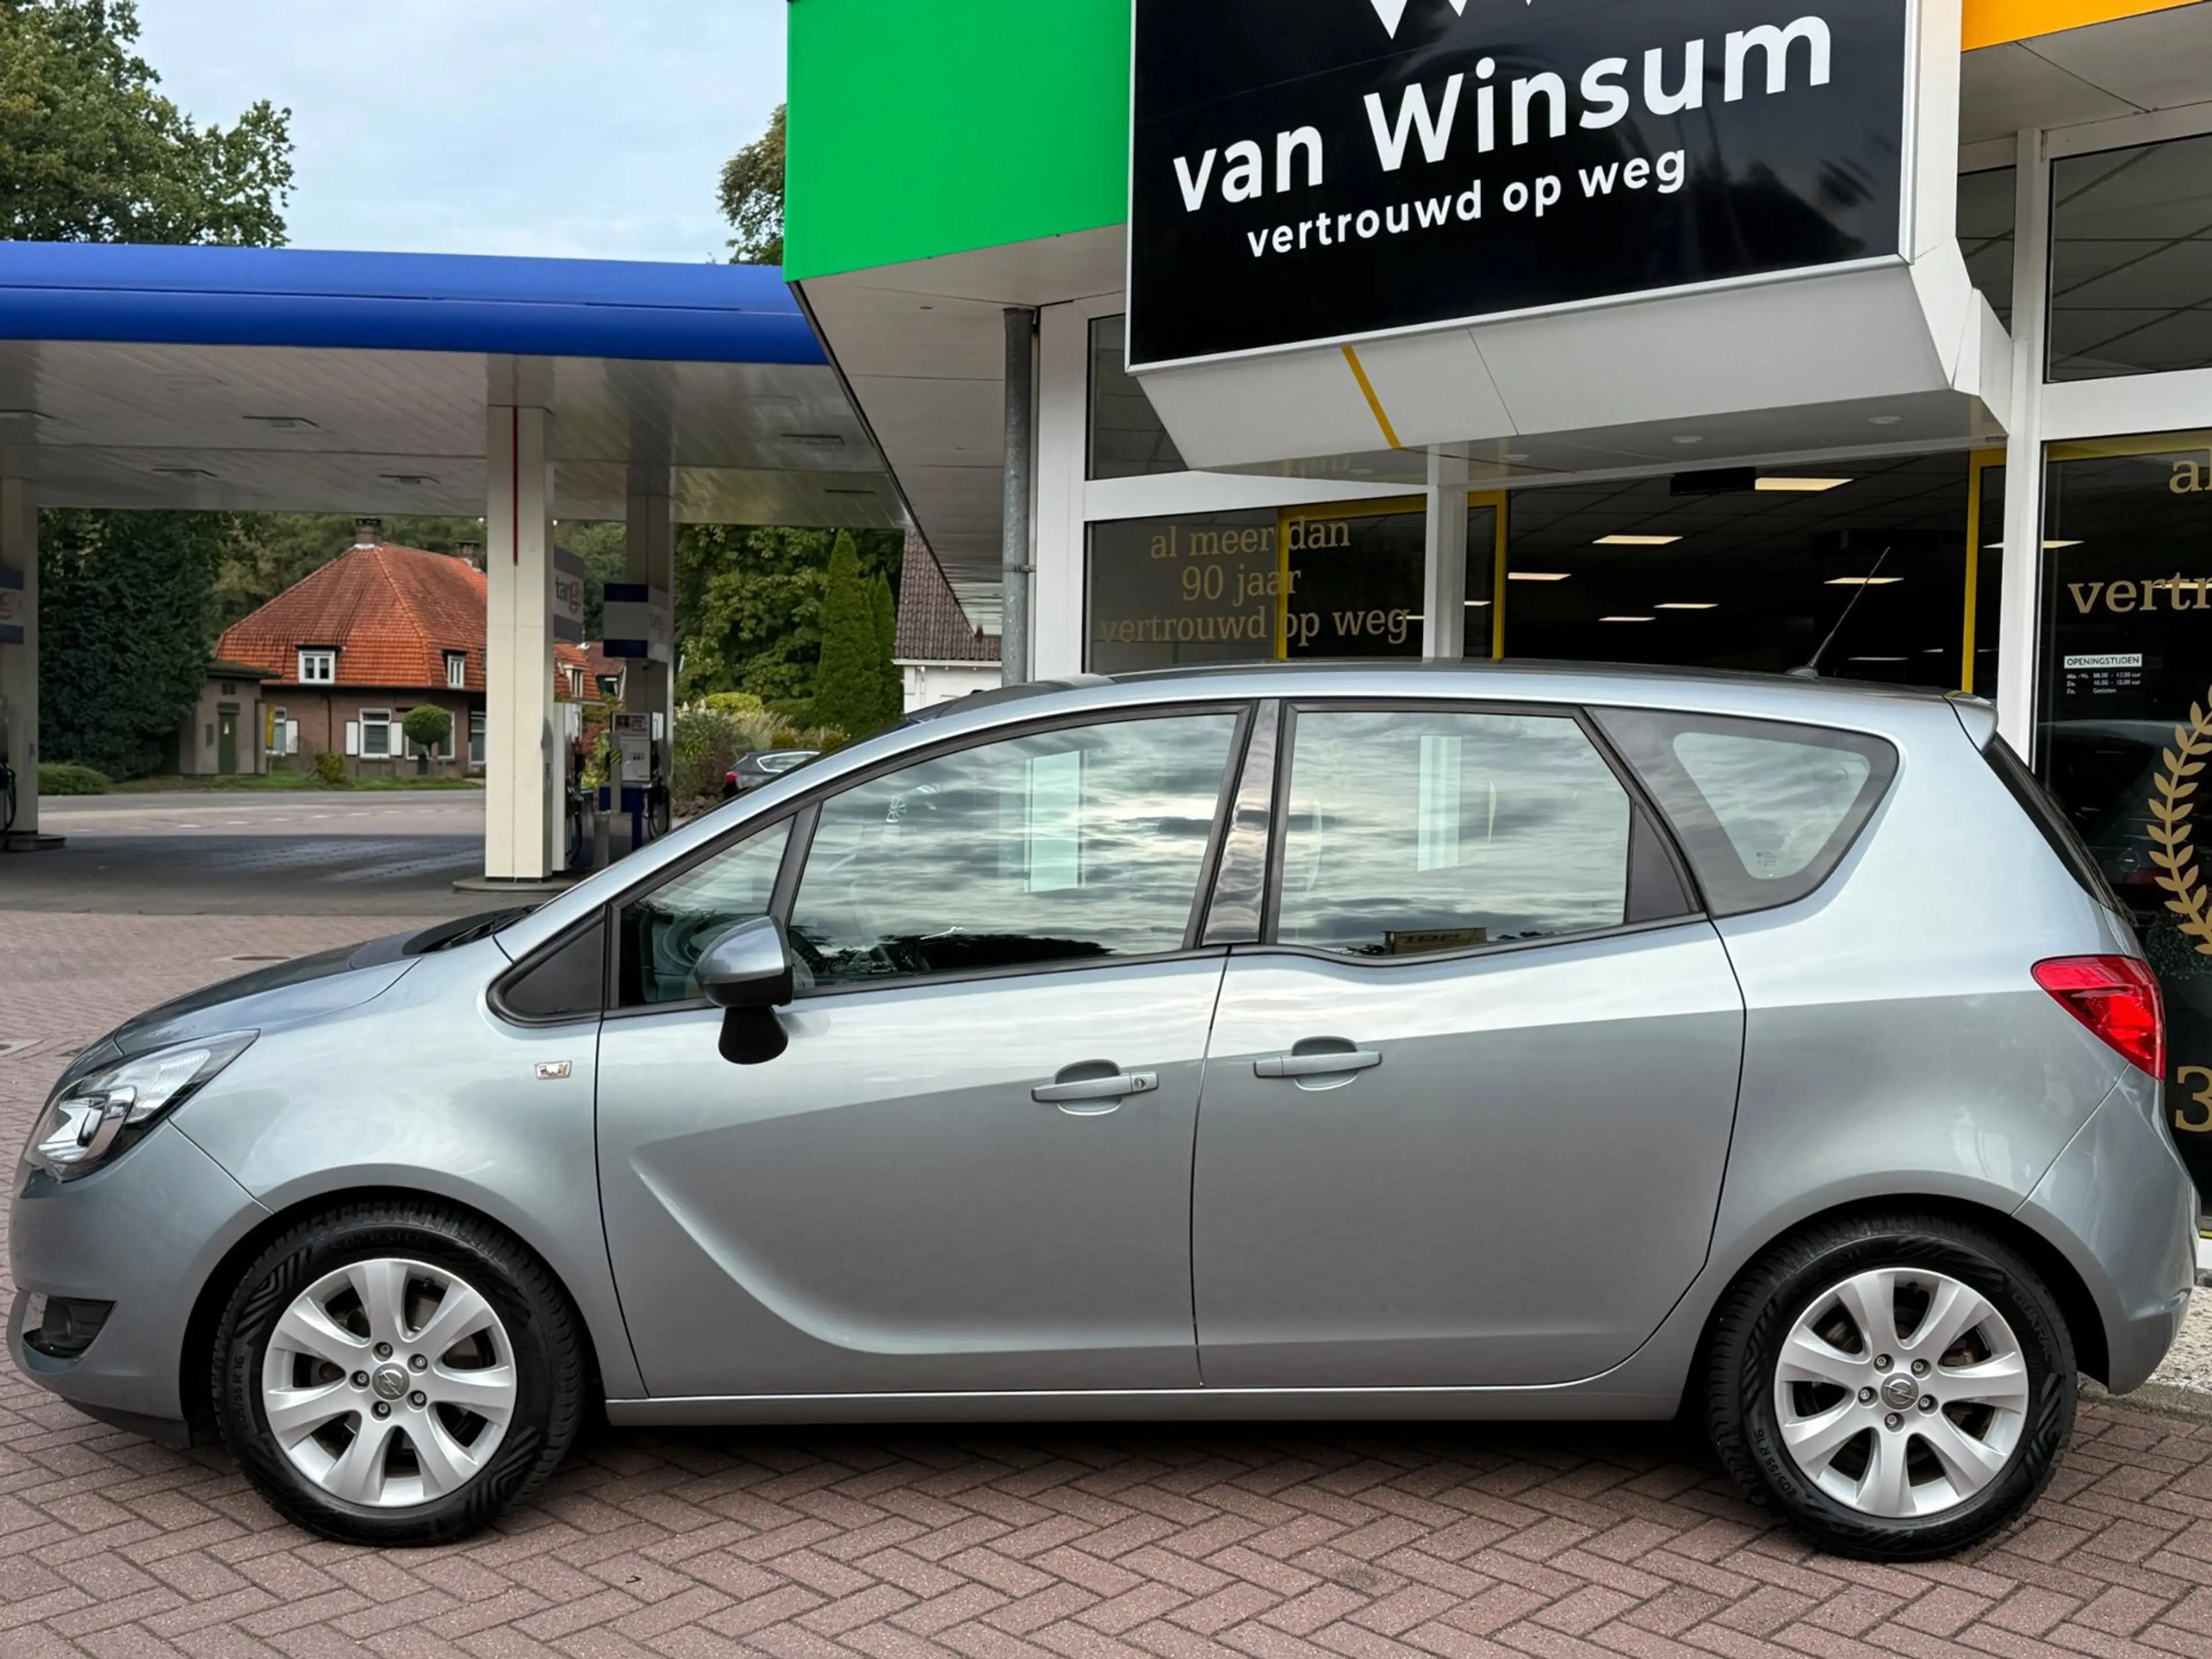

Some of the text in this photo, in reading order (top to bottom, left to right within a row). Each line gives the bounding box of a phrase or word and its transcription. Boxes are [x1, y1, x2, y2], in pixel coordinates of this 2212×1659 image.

[1173, 15, 1831, 213] van Winsum
[1247, 149, 1685, 257] vertrouwd op weg
[1150, 515, 1351, 559] al meer dan
[1181, 563, 1301, 607] 90 jaar
[1100, 605, 1411, 646] vertrouwd op weg
[2066, 656, 2139, 666] OPENINGSTIJDEN
[1764, 1457, 1797, 1499] 205/55
